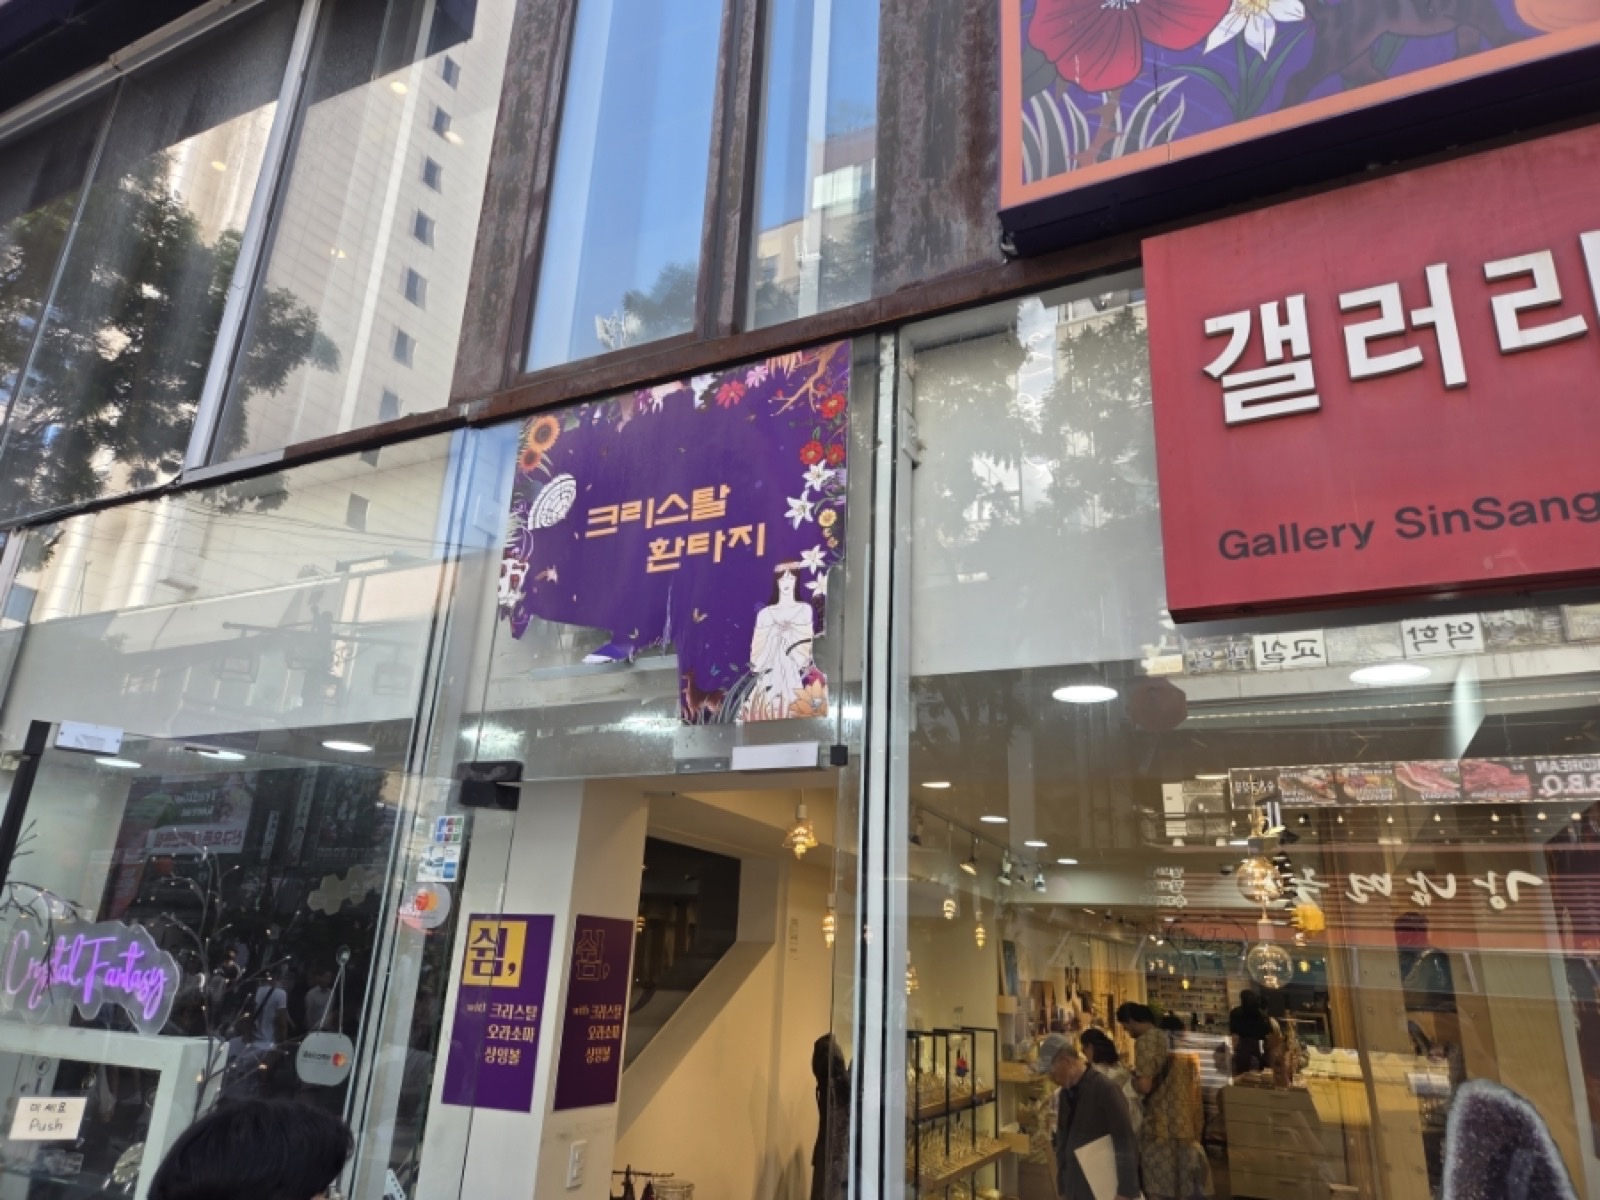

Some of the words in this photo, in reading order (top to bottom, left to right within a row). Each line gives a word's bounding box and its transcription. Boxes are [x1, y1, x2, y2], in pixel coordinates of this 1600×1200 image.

[1203, 230, 1600, 427] 갤러리
[585, 484, 731, 538] 크리스탈
[1218, 520, 1375, 560] Gallery
[1395, 490, 1600, 540] SinSang
[646, 522, 766, 573] 환타지
[82, 936, 168, 1020] Fantasy
[470, 927, 516, 977] 쉼,
[29, 1117, 63, 1131] Push
